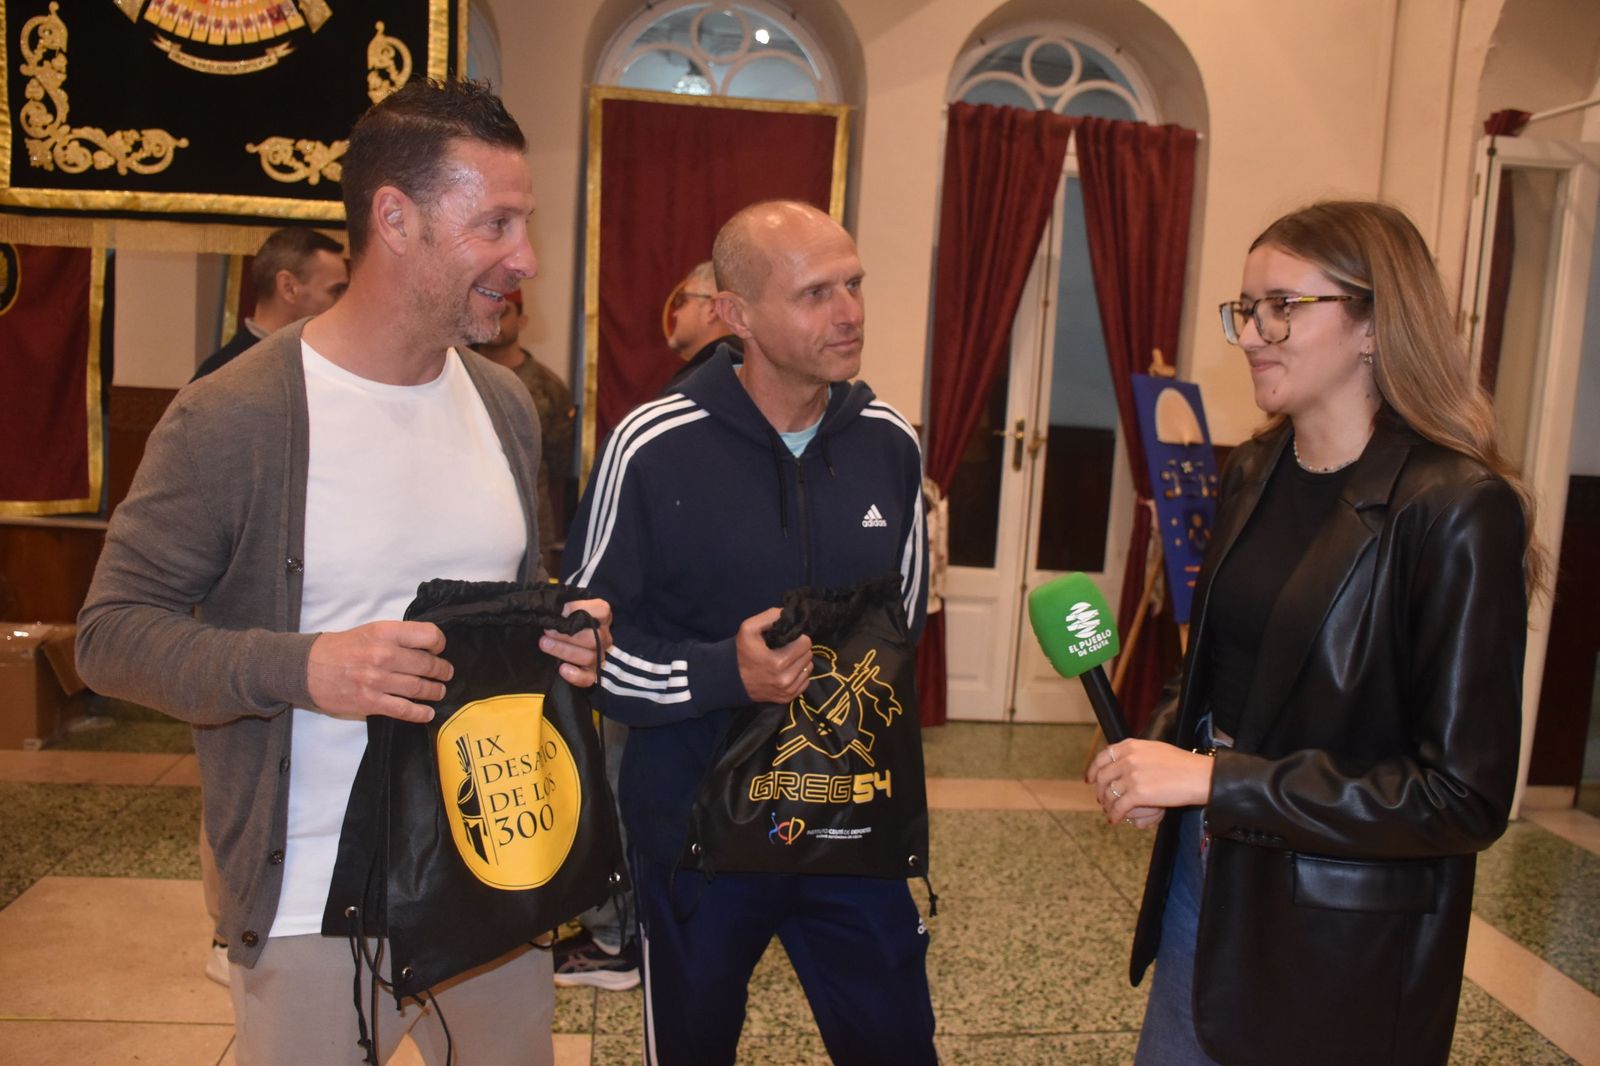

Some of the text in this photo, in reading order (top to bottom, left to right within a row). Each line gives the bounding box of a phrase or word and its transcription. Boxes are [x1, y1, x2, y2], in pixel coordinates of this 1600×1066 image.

[1068, 629, 1111, 653] EL PUEBLO
[476, 735, 506, 758] IX
[488, 786, 526, 814] DE
[749, 769, 892, 804] GREG54
[495, 803, 554, 847] 300
